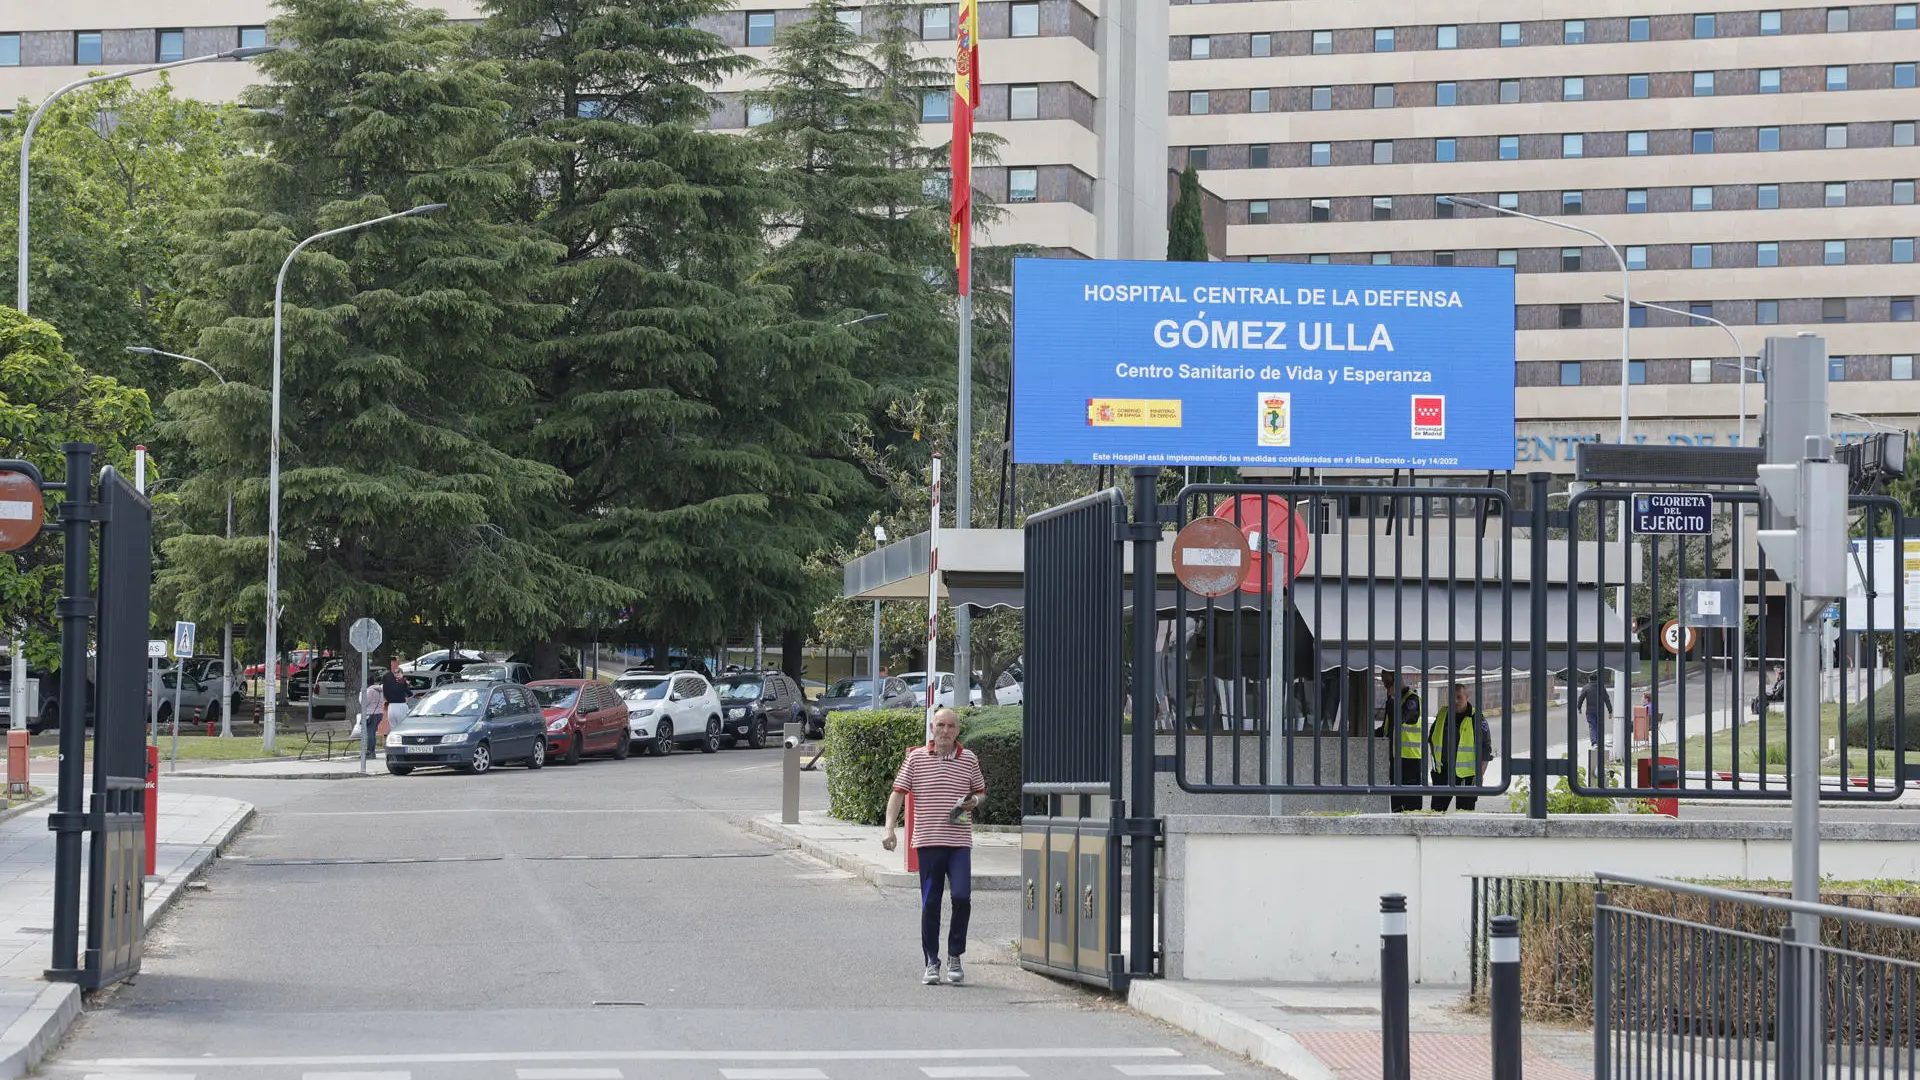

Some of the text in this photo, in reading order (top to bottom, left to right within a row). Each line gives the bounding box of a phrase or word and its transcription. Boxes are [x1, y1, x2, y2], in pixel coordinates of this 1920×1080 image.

[1084, 284, 1463, 308] HOSPITAL CENTRAL DE LA DEFENSA
[1153, 310, 1394, 352] GÓMEZ ULLA
[1115, 362, 1432, 386] Centro Sanitario de Vida y Esperanza
[1092, 452, 1111, 461] Este
[1112, 453, 1146, 463] Hospital
[1147, 453, 1165, 462] está
[1166, 454, 1228, 463] implementando
[1229, 455, 1242, 463] las
[1243, 455, 1277, 464] medidas
[1278, 456, 1332, 465] consideradas
[1345, 457, 1353, 465] el
[1354, 457, 1373, 465] Real
[1374, 457, 1406, 466] Decreto
[1412, 458, 1427, 467] Ley
[1429, 458, 1458, 466] 14/2022
[1653, 496, 1706, 508] GLORIETA
[1641, 516, 1704, 531] EJERCITO
